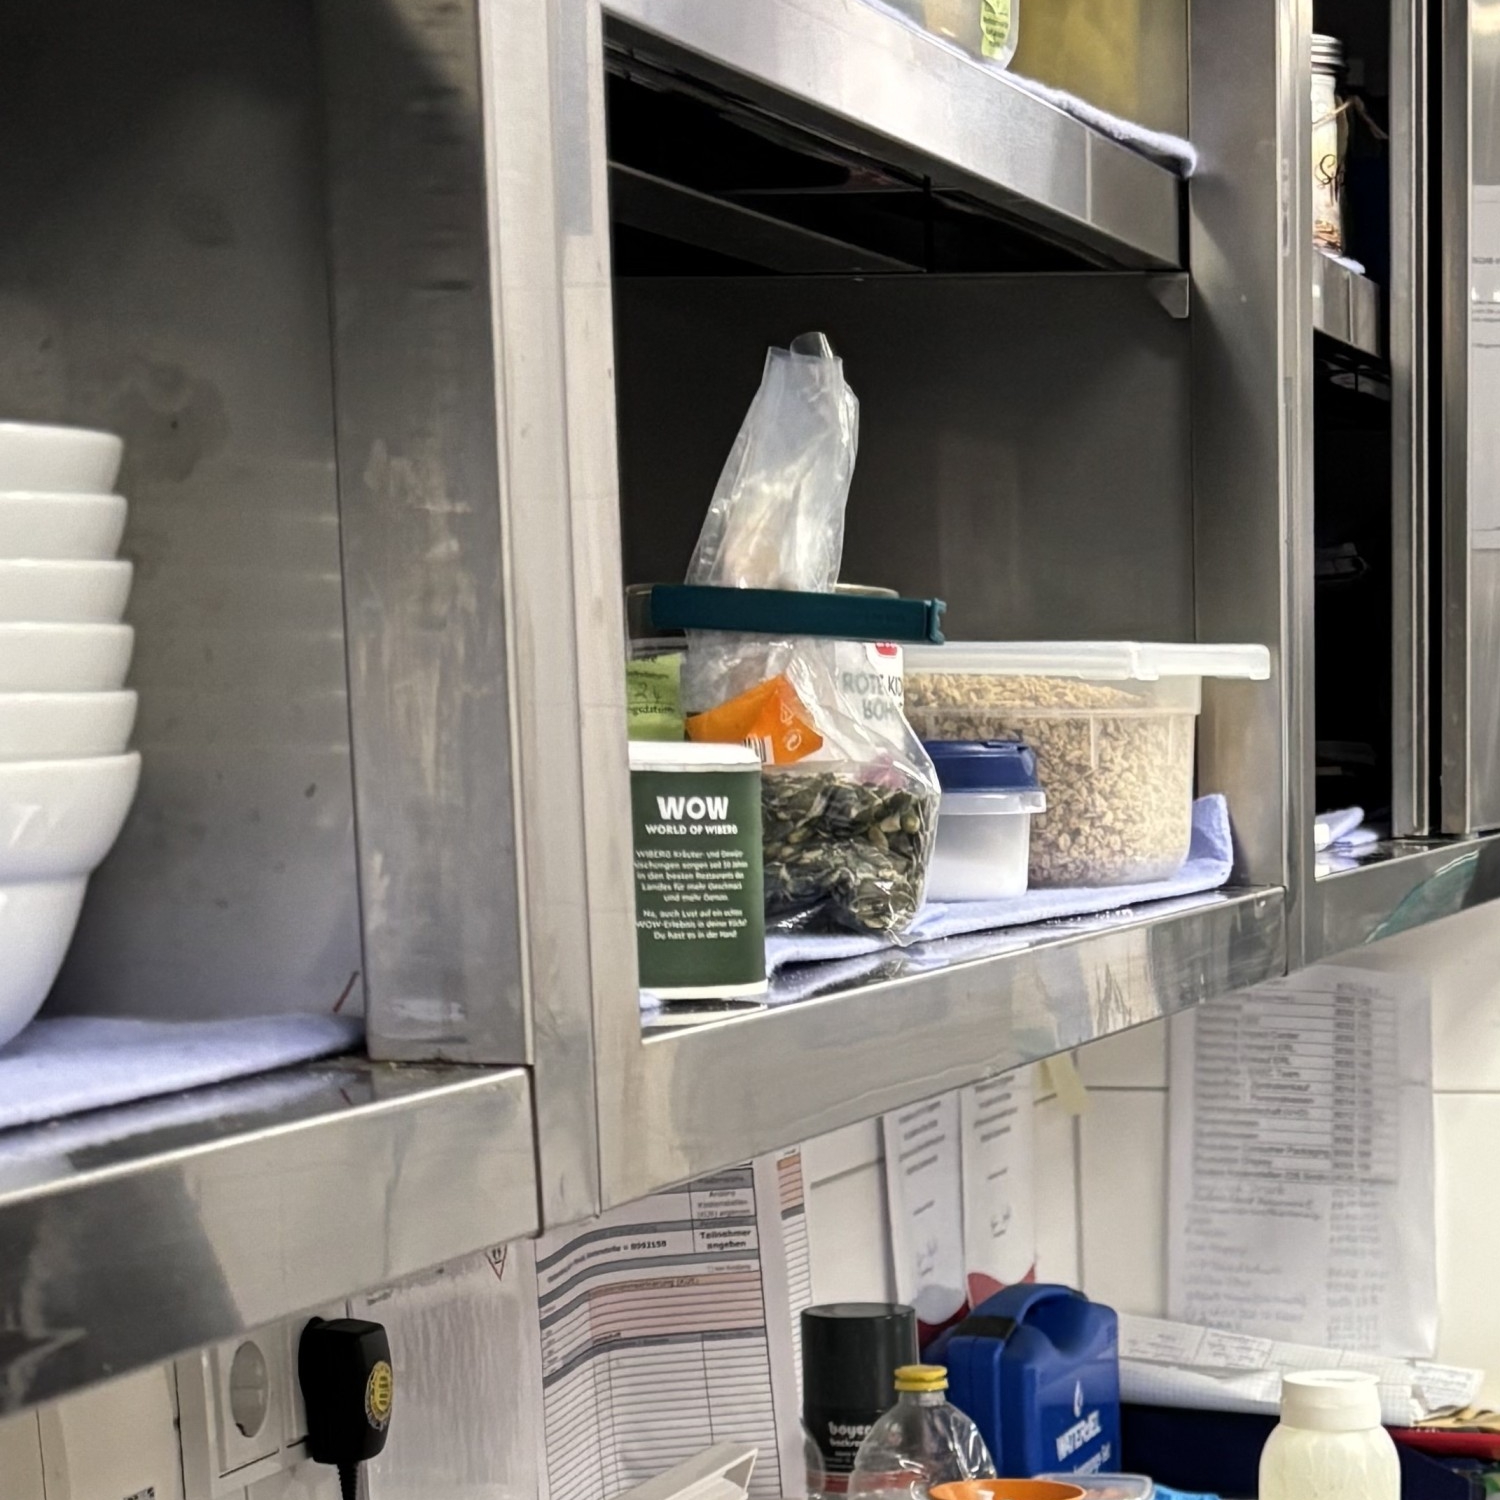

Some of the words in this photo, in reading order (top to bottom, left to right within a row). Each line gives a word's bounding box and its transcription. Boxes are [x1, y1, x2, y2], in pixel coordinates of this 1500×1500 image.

[656, 795, 729, 820] WOW
[644, 823, 687, 835] WORLD
[689, 823, 704, 835] OF
[704, 823, 738, 835] WIBERG
